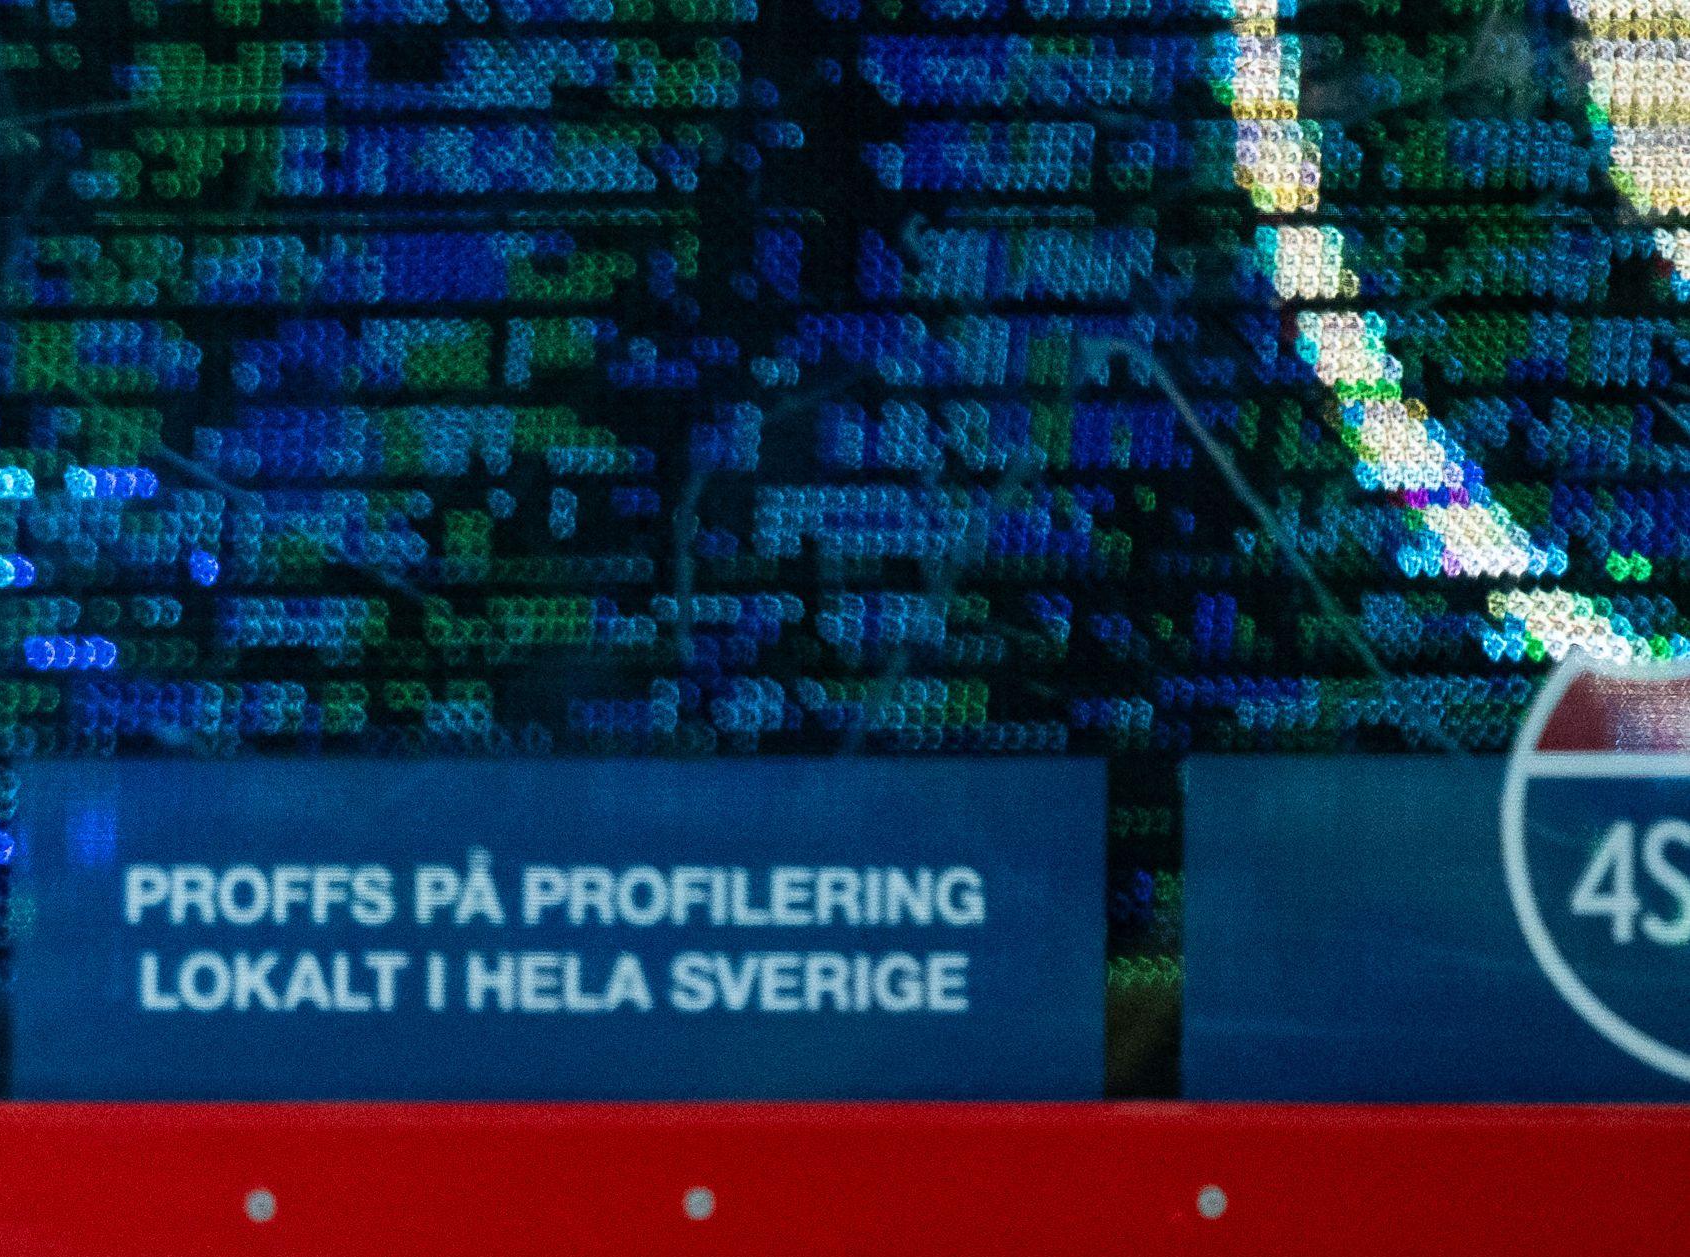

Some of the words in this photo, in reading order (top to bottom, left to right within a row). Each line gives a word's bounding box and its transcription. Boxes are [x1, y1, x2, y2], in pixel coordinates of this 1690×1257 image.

[125, 865, 395, 925] PROFFS
[417, 845, 505, 925] PÅ
[523, 865, 987, 925] PROFILERING
[139, 954, 409, 1012] LOKALT
[427, 954, 446, 1012] I
[467, 953, 652, 1012] HELA
[670, 953, 971, 1012] SVERIGE
